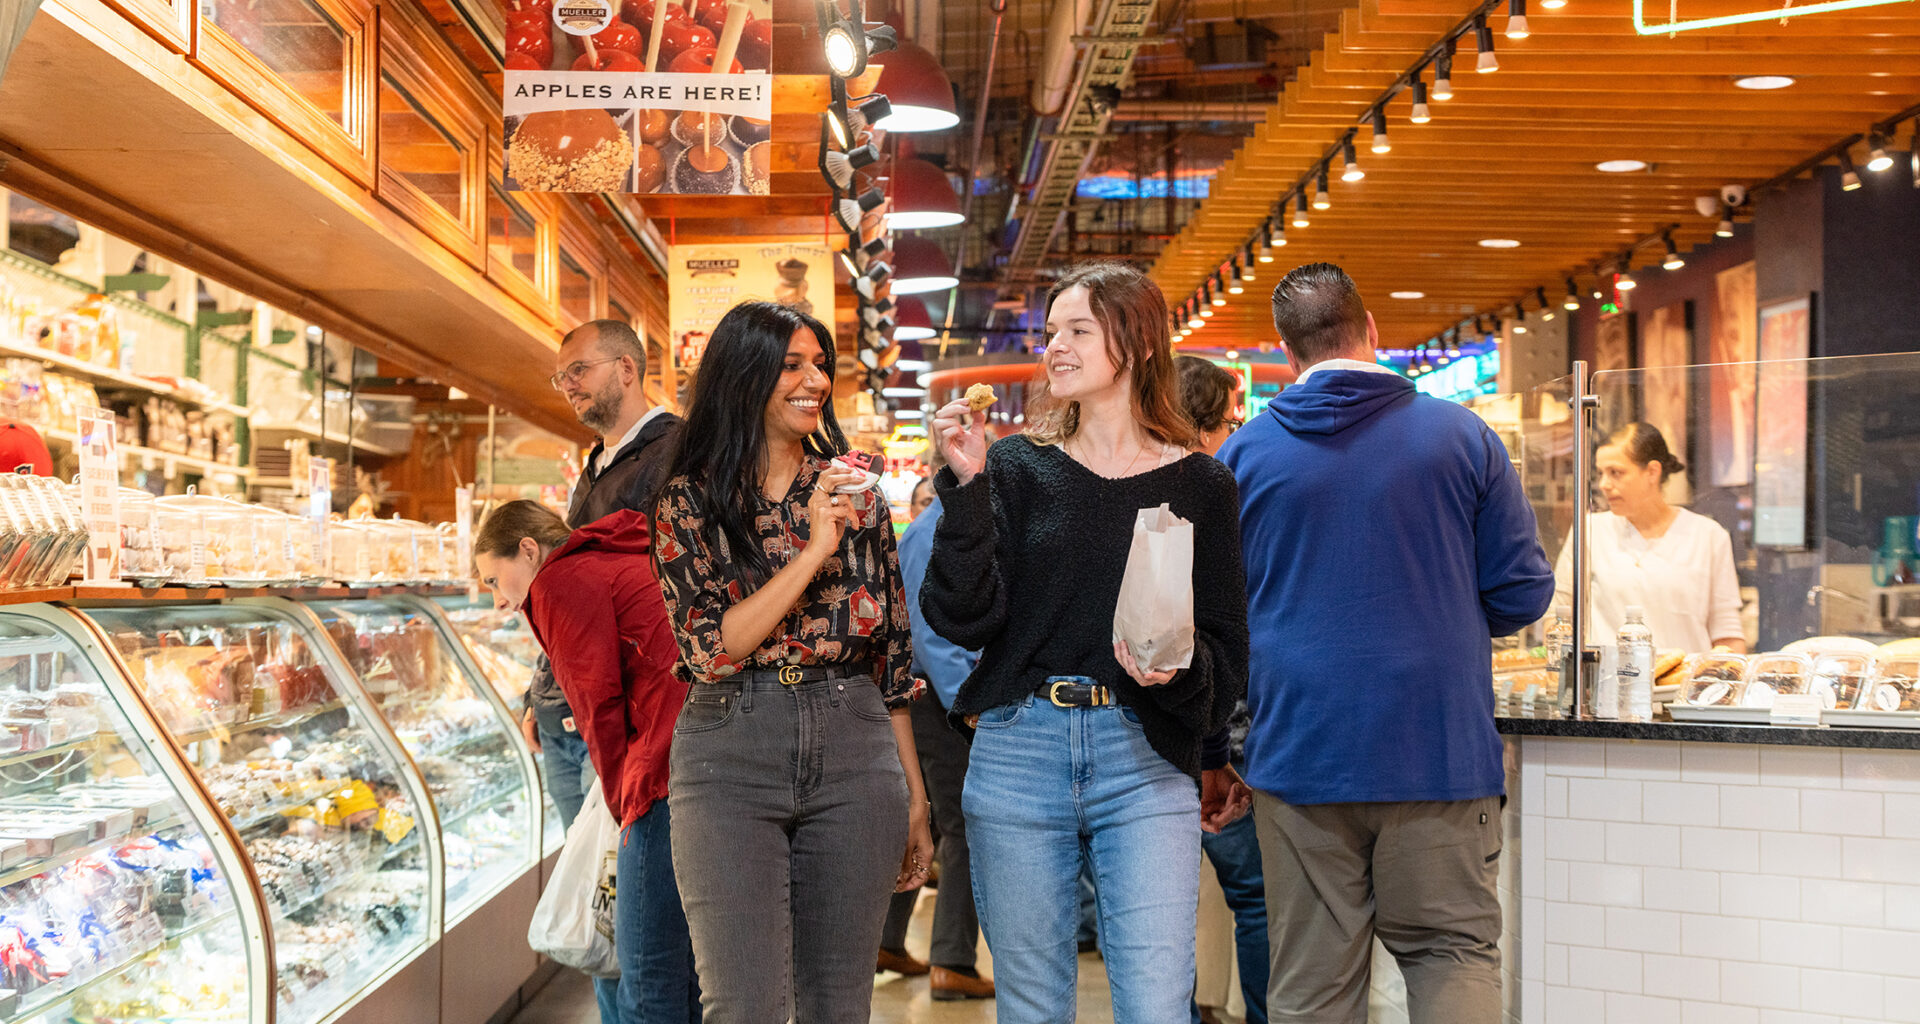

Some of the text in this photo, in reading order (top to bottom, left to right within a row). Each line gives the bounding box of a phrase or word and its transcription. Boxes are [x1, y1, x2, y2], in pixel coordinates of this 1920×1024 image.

[561, 8, 605, 16] MUELLER
[514, 83, 762, 101] APPLES ARE HERE!
[688, 260, 737, 268] MUELLER
